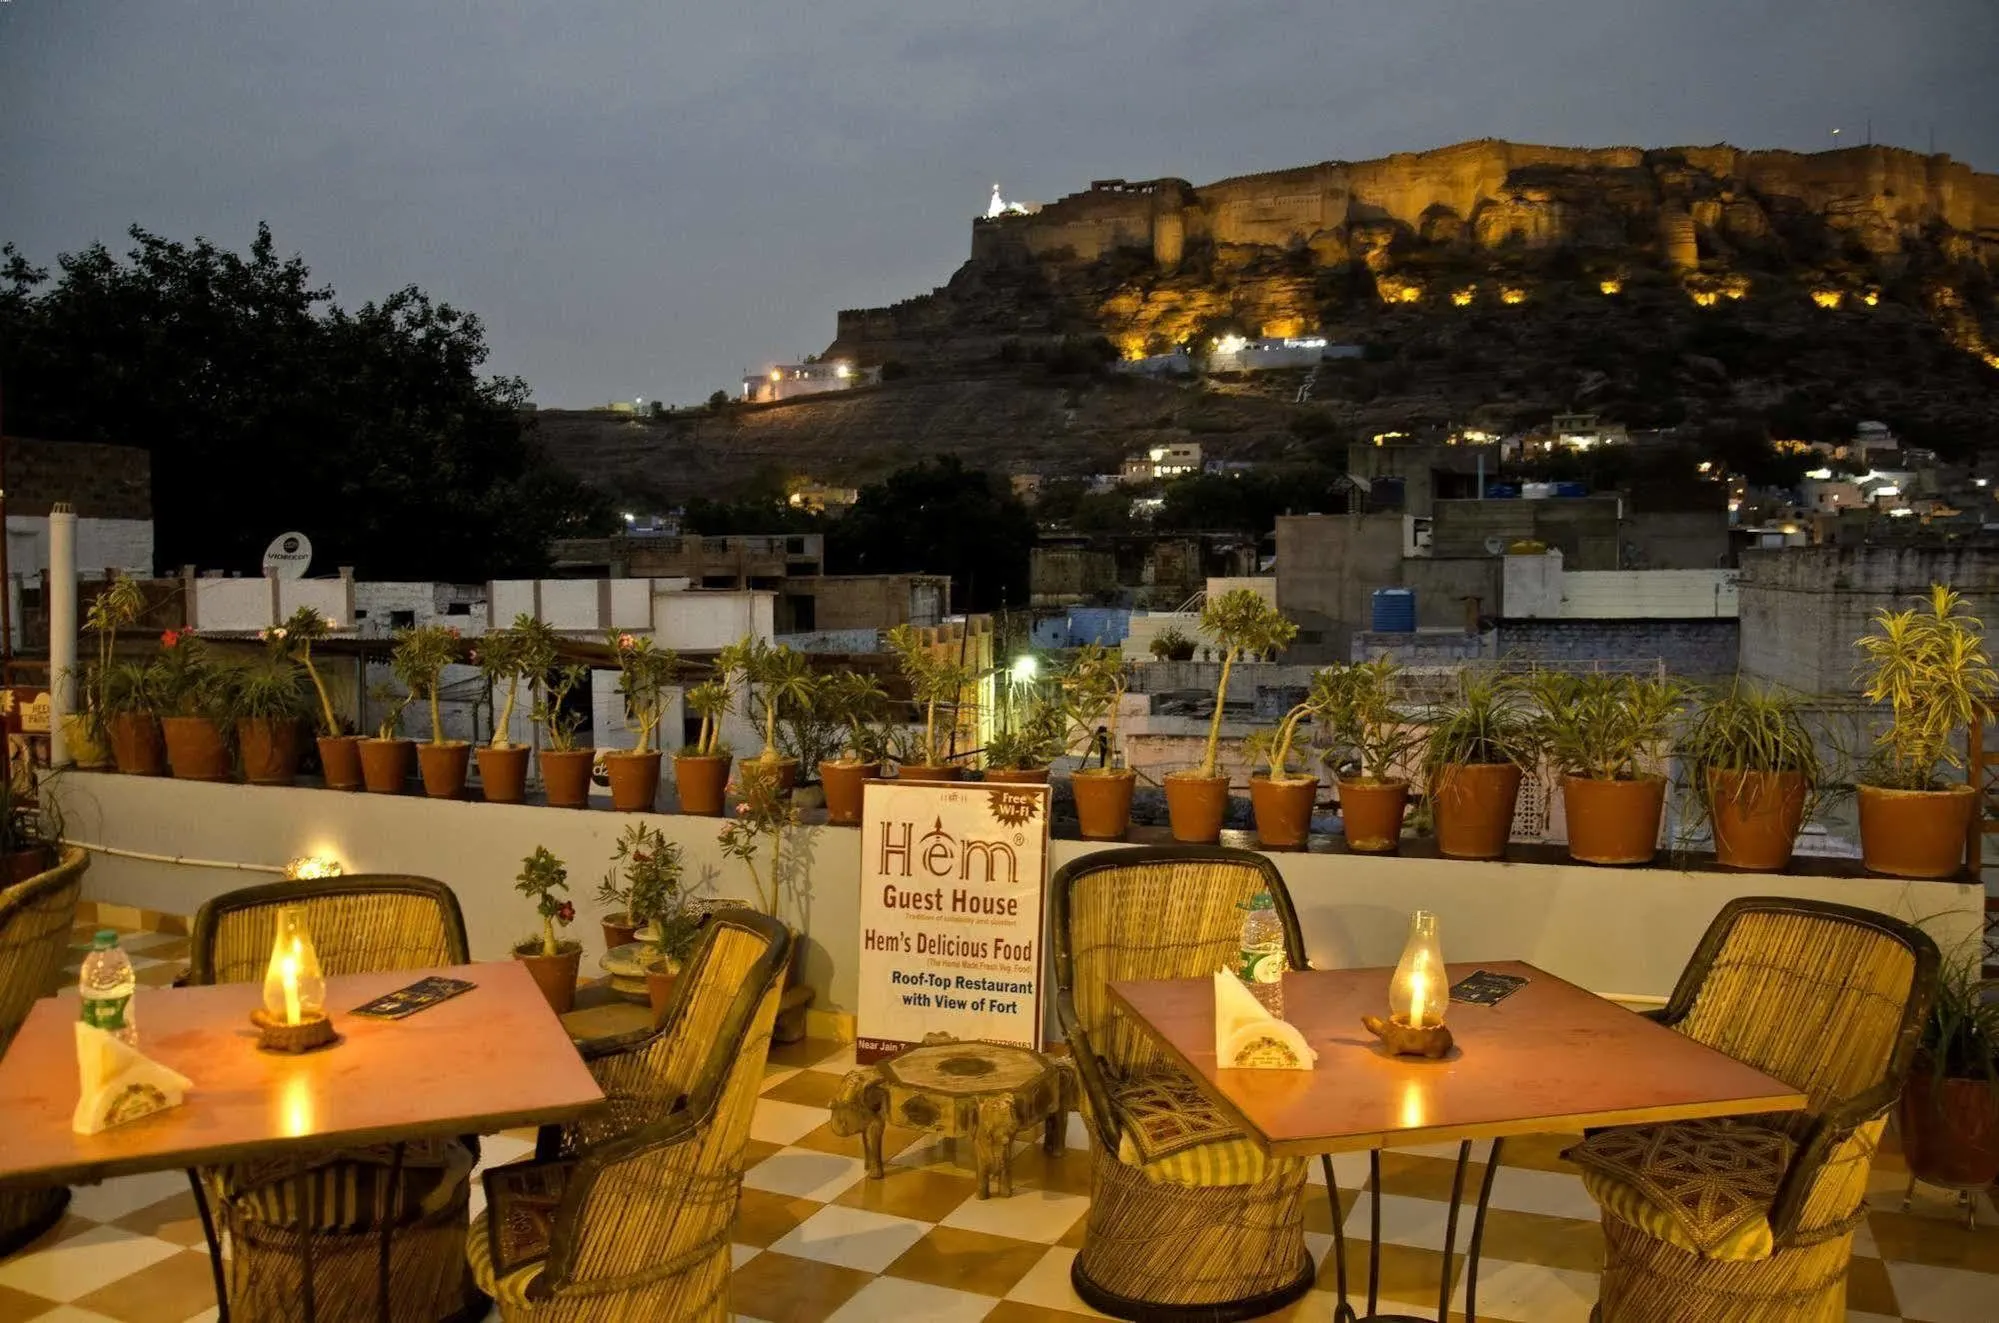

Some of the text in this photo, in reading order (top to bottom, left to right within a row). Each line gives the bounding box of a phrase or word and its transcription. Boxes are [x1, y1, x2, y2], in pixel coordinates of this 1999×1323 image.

[1002, 792, 1027, 804] Free
[883, 884, 1018, 916] Guest House
[865, 928, 1032, 962] Hem's Delicious Food
[892, 971, 1033, 994] Roof-Top Restaurant
[902, 992, 1018, 1014] with View of Fort
[858, 1039, 878, 1050] Near
[880, 1041, 898, 1052] Jain
